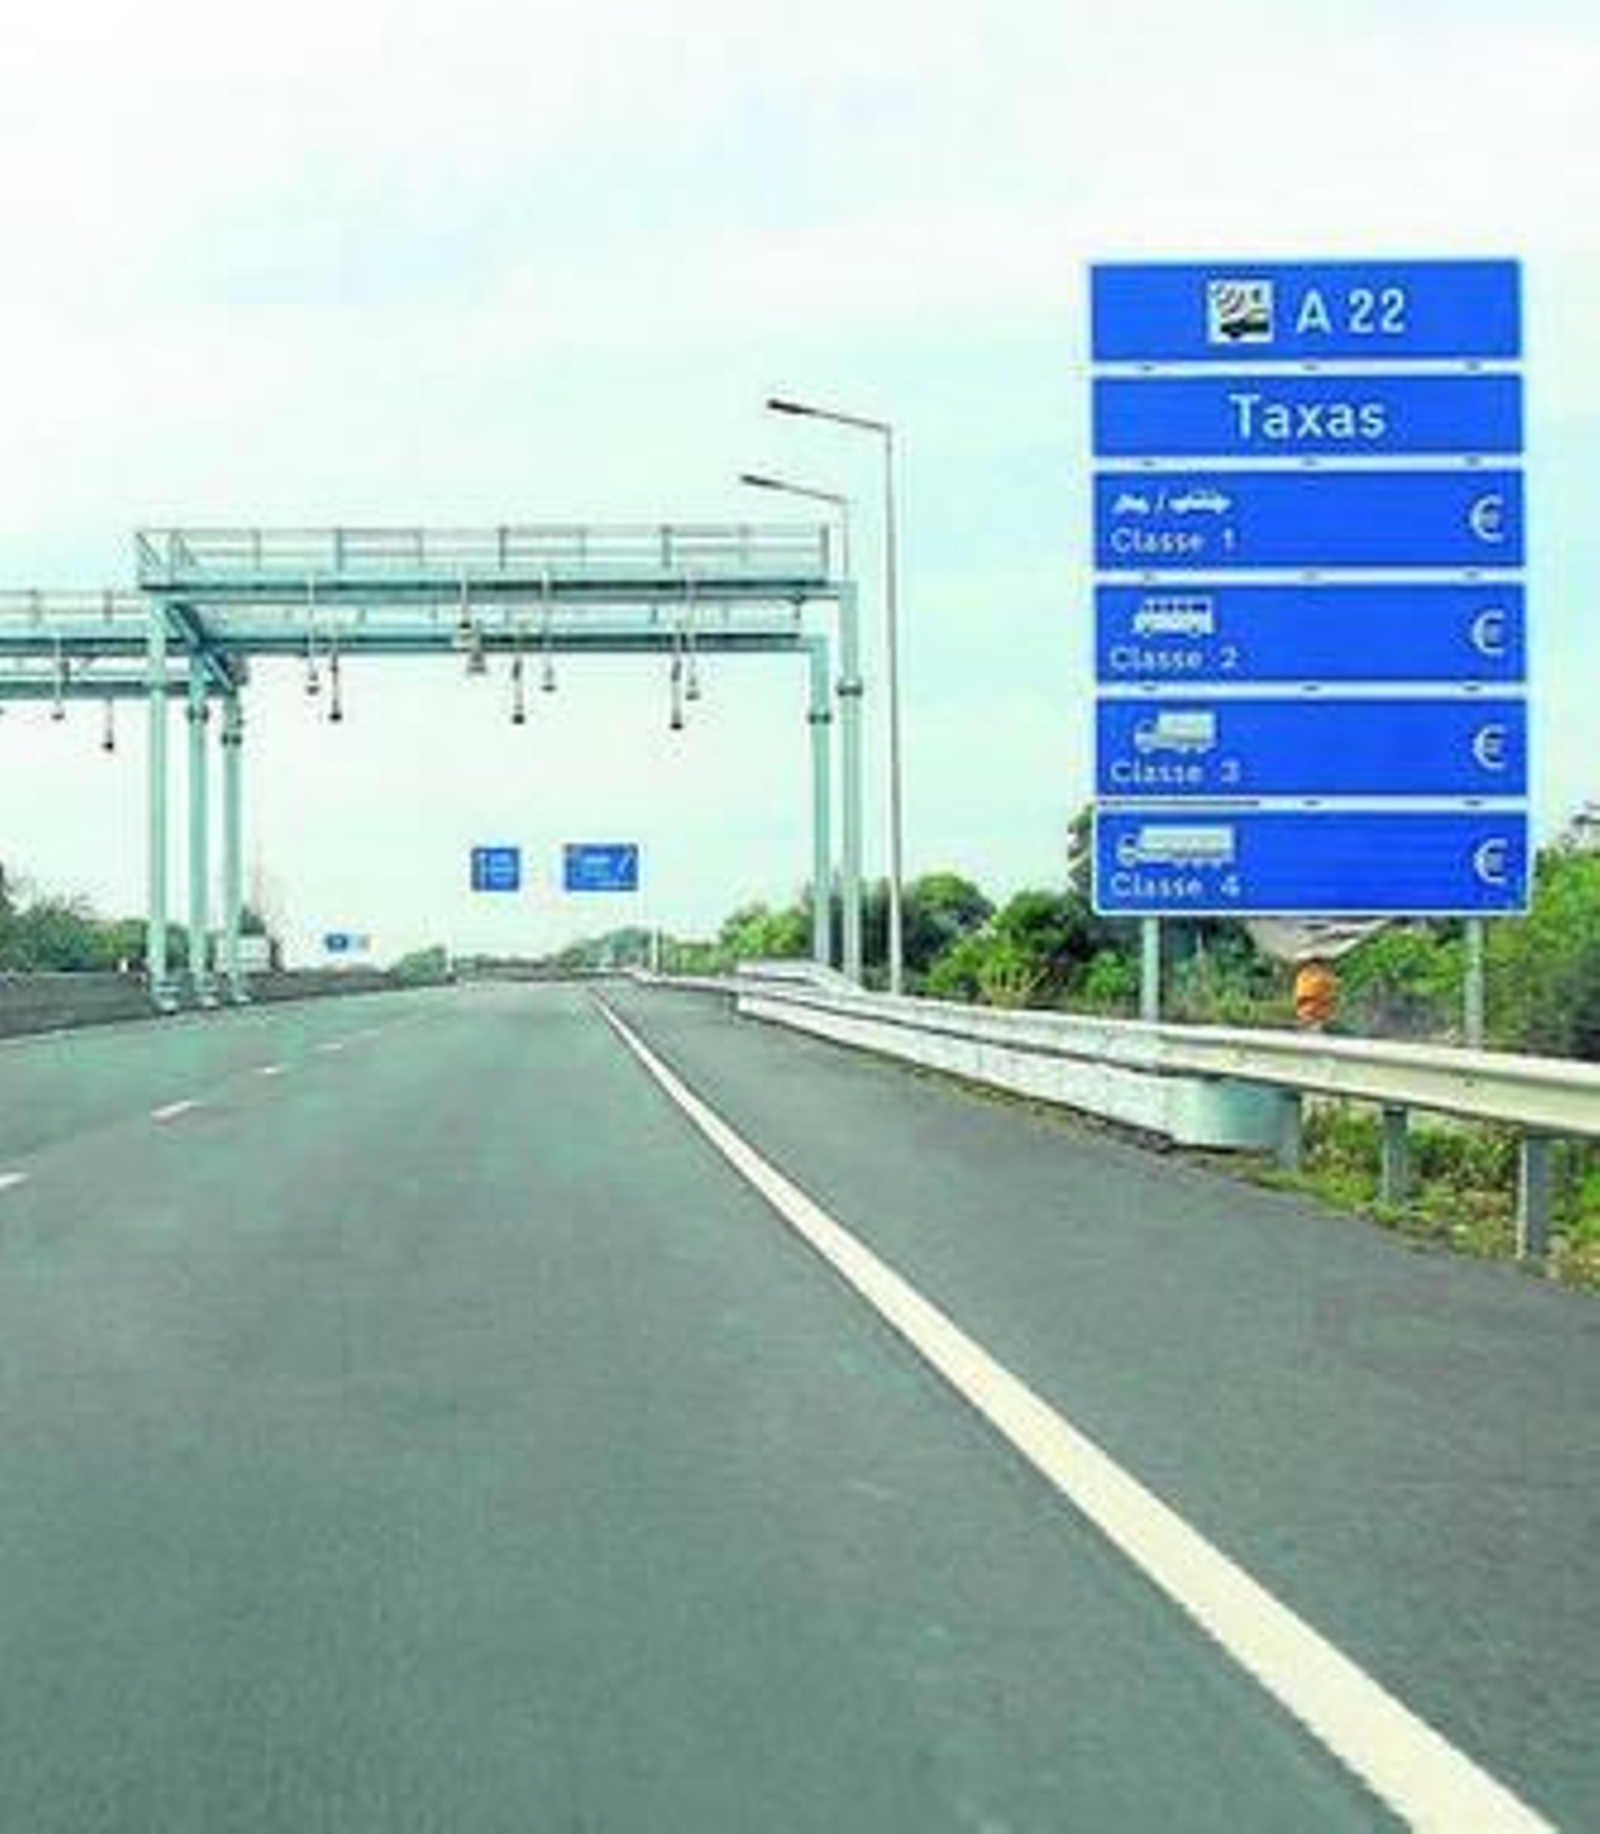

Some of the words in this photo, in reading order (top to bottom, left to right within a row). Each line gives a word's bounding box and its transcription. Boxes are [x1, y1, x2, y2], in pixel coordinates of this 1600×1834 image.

[1296, 290, 1331, 334] A
[1349, 288, 1405, 334] 22
[1229, 394, 1387, 439] Taxas
[1110, 528, 1204, 553] Classe
[1224, 529, 1236, 552] 1
[1469, 495, 1504, 543] €
[1472, 609, 1506, 656] €
[1110, 647, 1203, 670] Classe
[1220, 647, 1239, 669] 2
[1472, 724, 1506, 770] €
[1110, 760, 1203, 783] Classe
[1221, 761, 1241, 783] 3
[1474, 838, 1507, 884] €
[1110, 873, 1203, 897] Classe
[1220, 874, 1241, 897] 4
